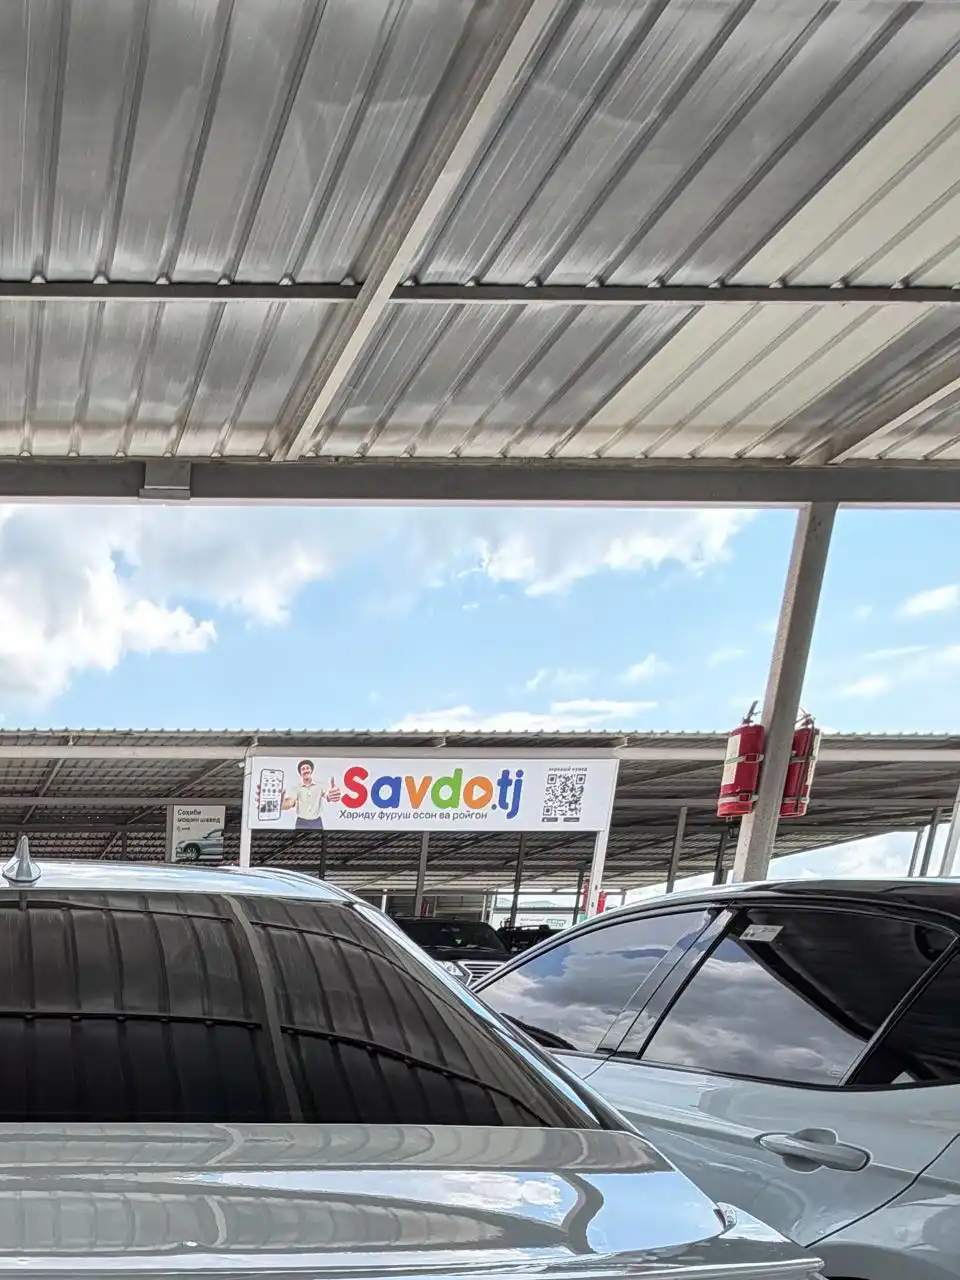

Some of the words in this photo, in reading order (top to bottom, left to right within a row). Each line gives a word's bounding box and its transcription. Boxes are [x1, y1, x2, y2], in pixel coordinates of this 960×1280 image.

[341, 766, 524, 819] Savdo.tj
[339, 810, 376, 820] Хариду
[378, 810, 411, 820] фуруш
[452, 810, 488, 821] ройгон
